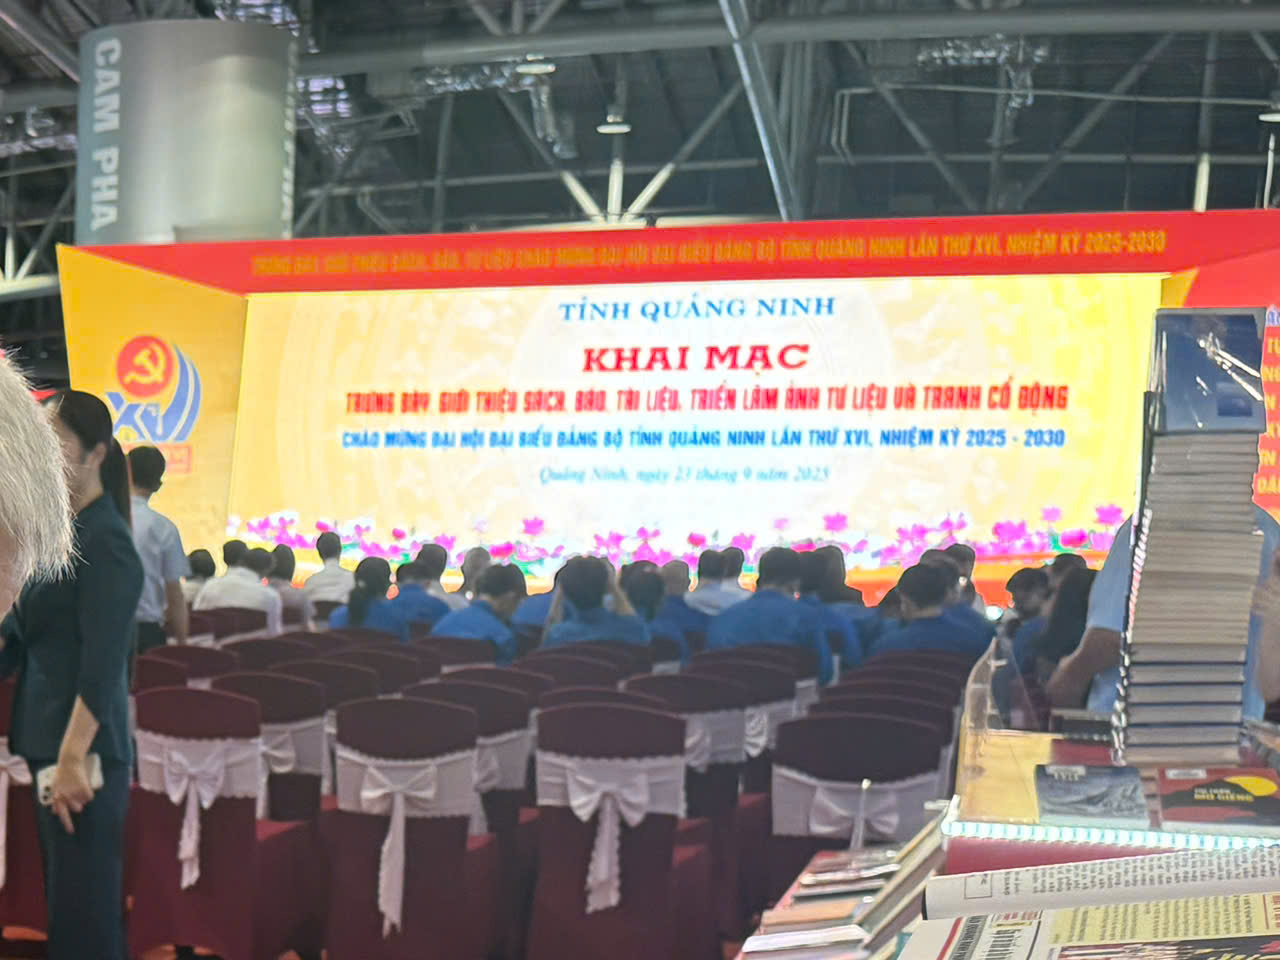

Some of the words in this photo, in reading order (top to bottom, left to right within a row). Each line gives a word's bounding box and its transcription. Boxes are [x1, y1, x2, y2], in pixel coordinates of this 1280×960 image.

[93, 38, 121, 133] CAM
[90, 146, 119, 231] PHA
[1007, 230, 1057, 257] NHIỆM
[1085, 229, 1166, 254] 2025-2030
[560, 296, 631, 321] TỈNH
[640, 292, 746, 323] QUẢNG
[756, 297, 835, 318] NINH
[582, 346, 690, 372] KHAI
[704, 344, 810, 376] MẠC
[476, 387, 518, 415] THIỆU
[784, 380, 820, 411] ẢNH
[827, 386, 847, 411] TƯ
[852, 383, 888, 414] LIỆU
[894, 383, 916, 410] VÀ
[922, 385, 982, 411] TRANH
[987, 374, 1014, 411] CỔ
[1017, 381, 1070, 416] ĐỘNG
[384, 428, 428, 449] MỪNG
[557, 427, 598, 449] ĐẢNG
[604, 428, 623, 452] BỘ
[629, 427, 664, 448] TỈNH
[668, 427, 720, 450] QUẢNG
[727, 428, 766, 447] NINH
[771, 424, 802, 447] LẦN
[808, 426, 839, 447] THỨ
[843, 428, 873, 450] XVI,
[879, 425, 934, 450] NHIỆM
[965, 429, 1006, 447] 2025
[1023, 429, 1066, 448] 2030
[696, 465, 738, 486] tháng
